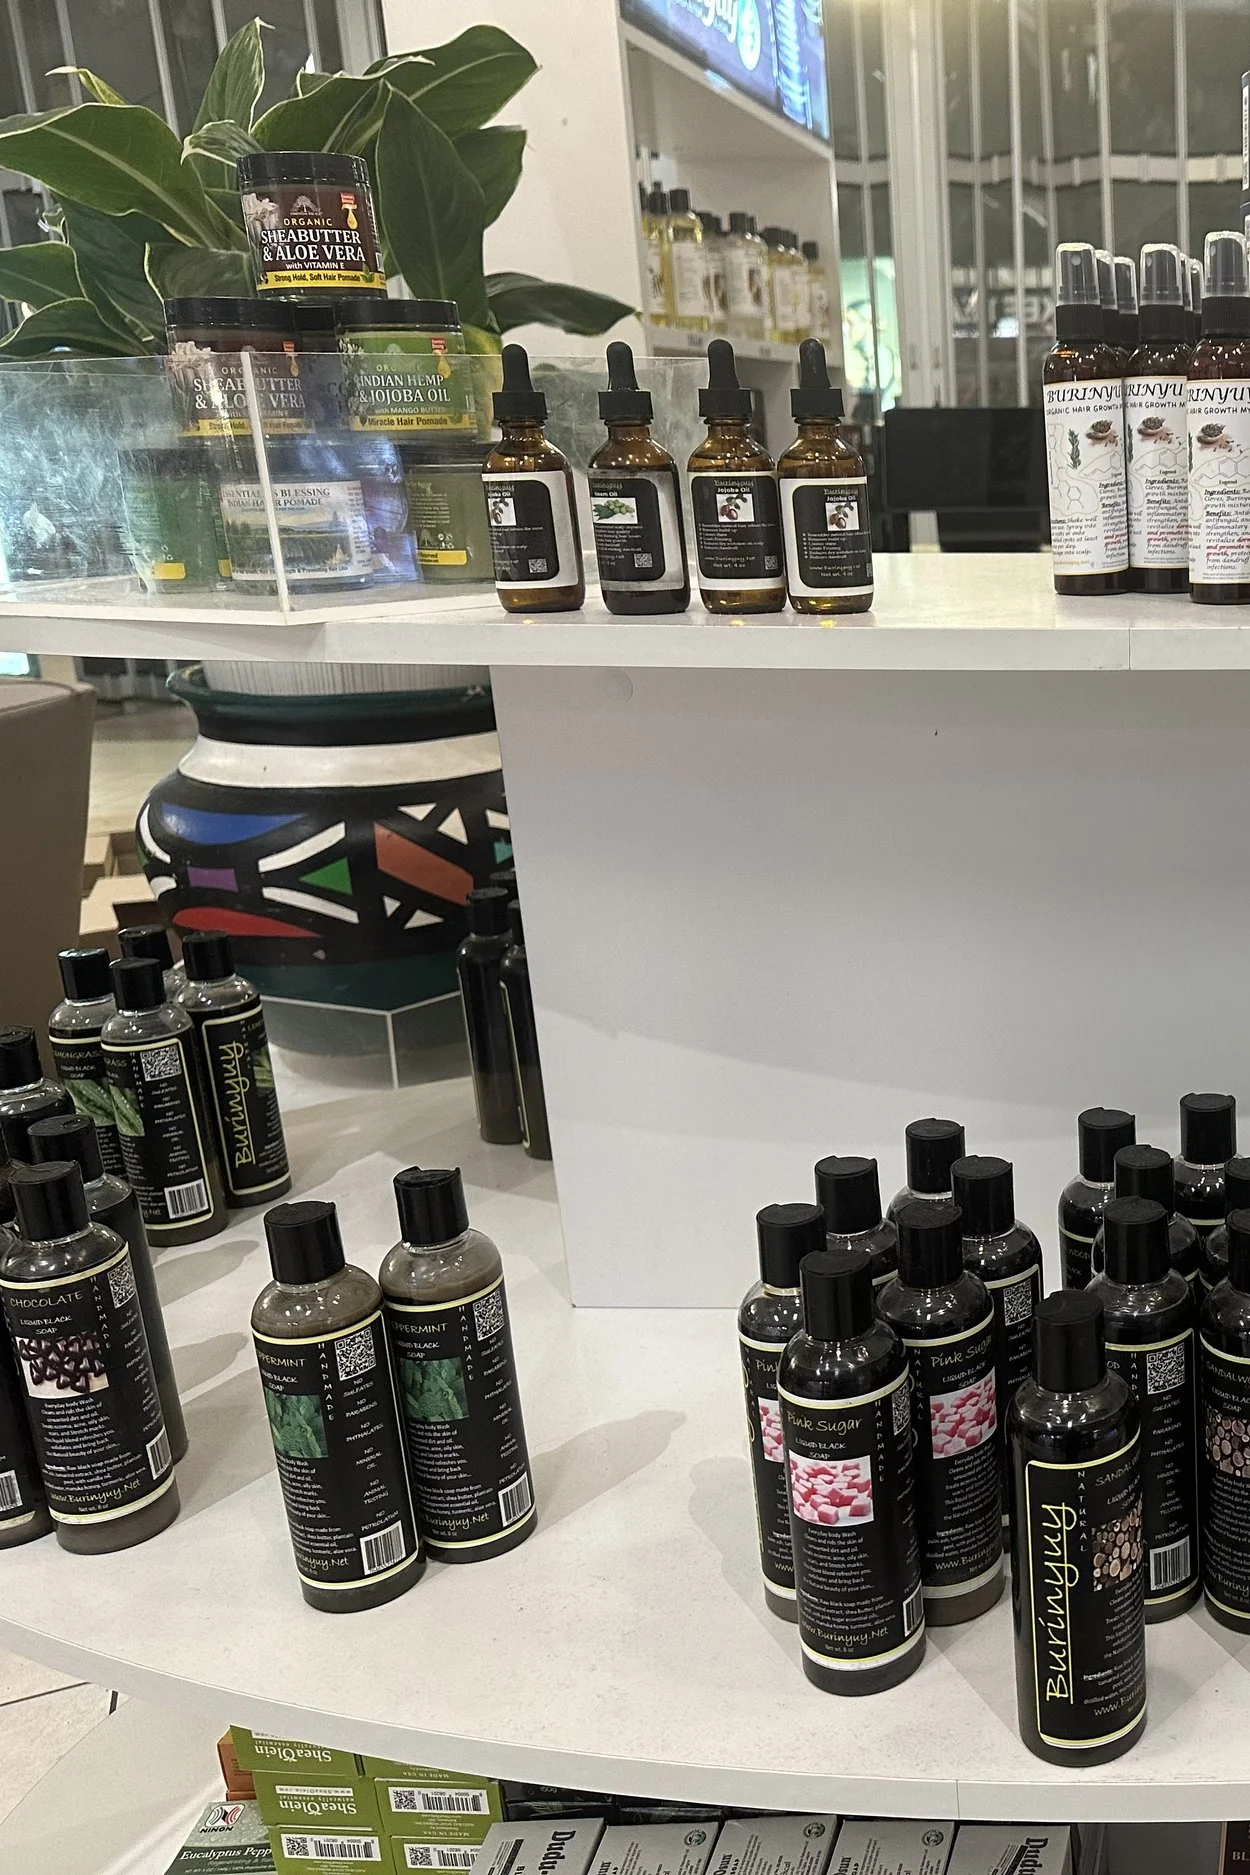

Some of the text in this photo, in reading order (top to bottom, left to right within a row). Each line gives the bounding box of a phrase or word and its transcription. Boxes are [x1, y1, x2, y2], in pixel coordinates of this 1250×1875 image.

[283, 218, 333, 227] ORGANIC
[261, 229, 361, 244] SHEABUTTER
[263, 245, 366, 262] & ALOE VERA
[285, 262, 303, 270] with
[274, 274, 291, 282] Strong
[309, 273, 322, 281] Soft
[323, 273, 336, 281] Hair
[337, 274, 361, 282] Pomade
[360, 374, 444, 387] INDIAN HEMP
[370, 389, 424, 404] JOJOBA
[427, 388, 451, 402] OIL
[368, 416, 448, 427] Miracle Hair Pomade
[280, 487, 331, 497] BLESSING
[1204, 488, 1241, 496] Ingredients:
[1205, 510, 1232, 518] Benefits:
[1222, 556, 1250, 564] dandruff
[219, 1040, 255, 1169] Burinyuy
[10, 1291, 83, 1308] CHOCOLATE
[413, 1341, 440, 1349] BLACK
[406, 1351, 426, 1359] SOAP
[931, 1336, 993, 1368] Pink Sugar
[787, 1412, 862, 1437] Pink Sugar
[821, 1442, 846, 1450] BLACK
[809, 1452, 831, 1460] SOAP
[1077, 1470, 1088, 1553] NATURAL
[1039, 1502, 1078, 1702] Burinyuy
[200, 1825, 234, 1834] NINON
[180, 1849, 242, 1861] Eucalyptus
